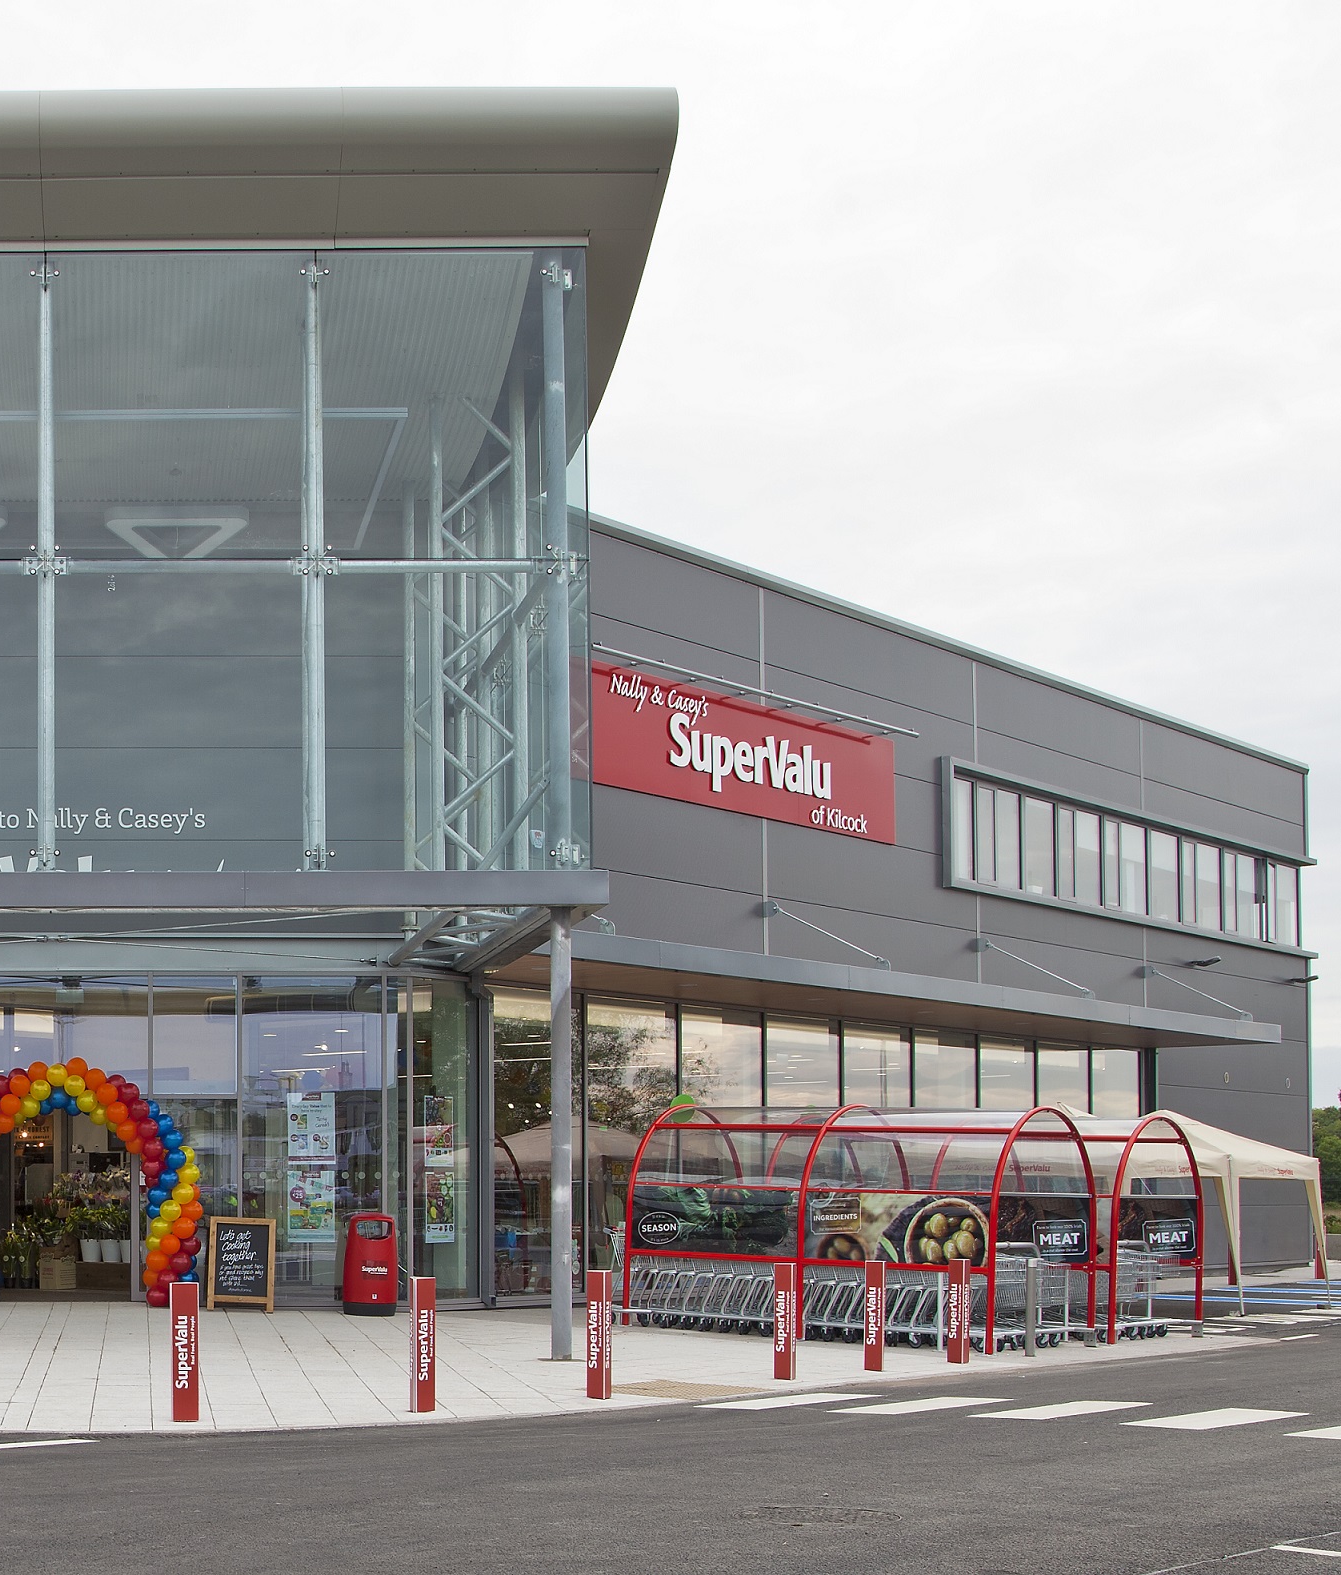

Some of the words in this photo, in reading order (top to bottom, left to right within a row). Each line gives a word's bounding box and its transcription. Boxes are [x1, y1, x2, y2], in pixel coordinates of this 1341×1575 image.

[610, 673, 648, 713] Nally
[651, 685, 664, 706] &
[667, 689, 709, 726] Casey's
[670, 713, 832, 800] SuperValu
[26, 808, 89, 835] Nlly
[94, 808, 112, 829] &
[117, 808, 206, 835] Casey's
[811, 805, 825, 825] of
[826, 807, 868, 834] Kilcock
[220, 1230, 234, 1240] Let's
[641, 1222, 677, 1233] SEASON
[813, 1212, 858, 1222] INGREDIENTS
[1149, 1231, 1189, 1244] MEAT
[1039, 1232, 1081, 1246] MEAT
[361, 1265, 388, 1273] SuperValu
[776, 1291, 787, 1353] SuperValu
[867, 1287, 878, 1345] SuperValu
[949, 1283, 959, 1338] SuperValu
[175, 1315, 192, 1389] SuperValu
[419, 1309, 431, 1381] SuperValu
[589, 1301, 599, 1369] SuperValu
